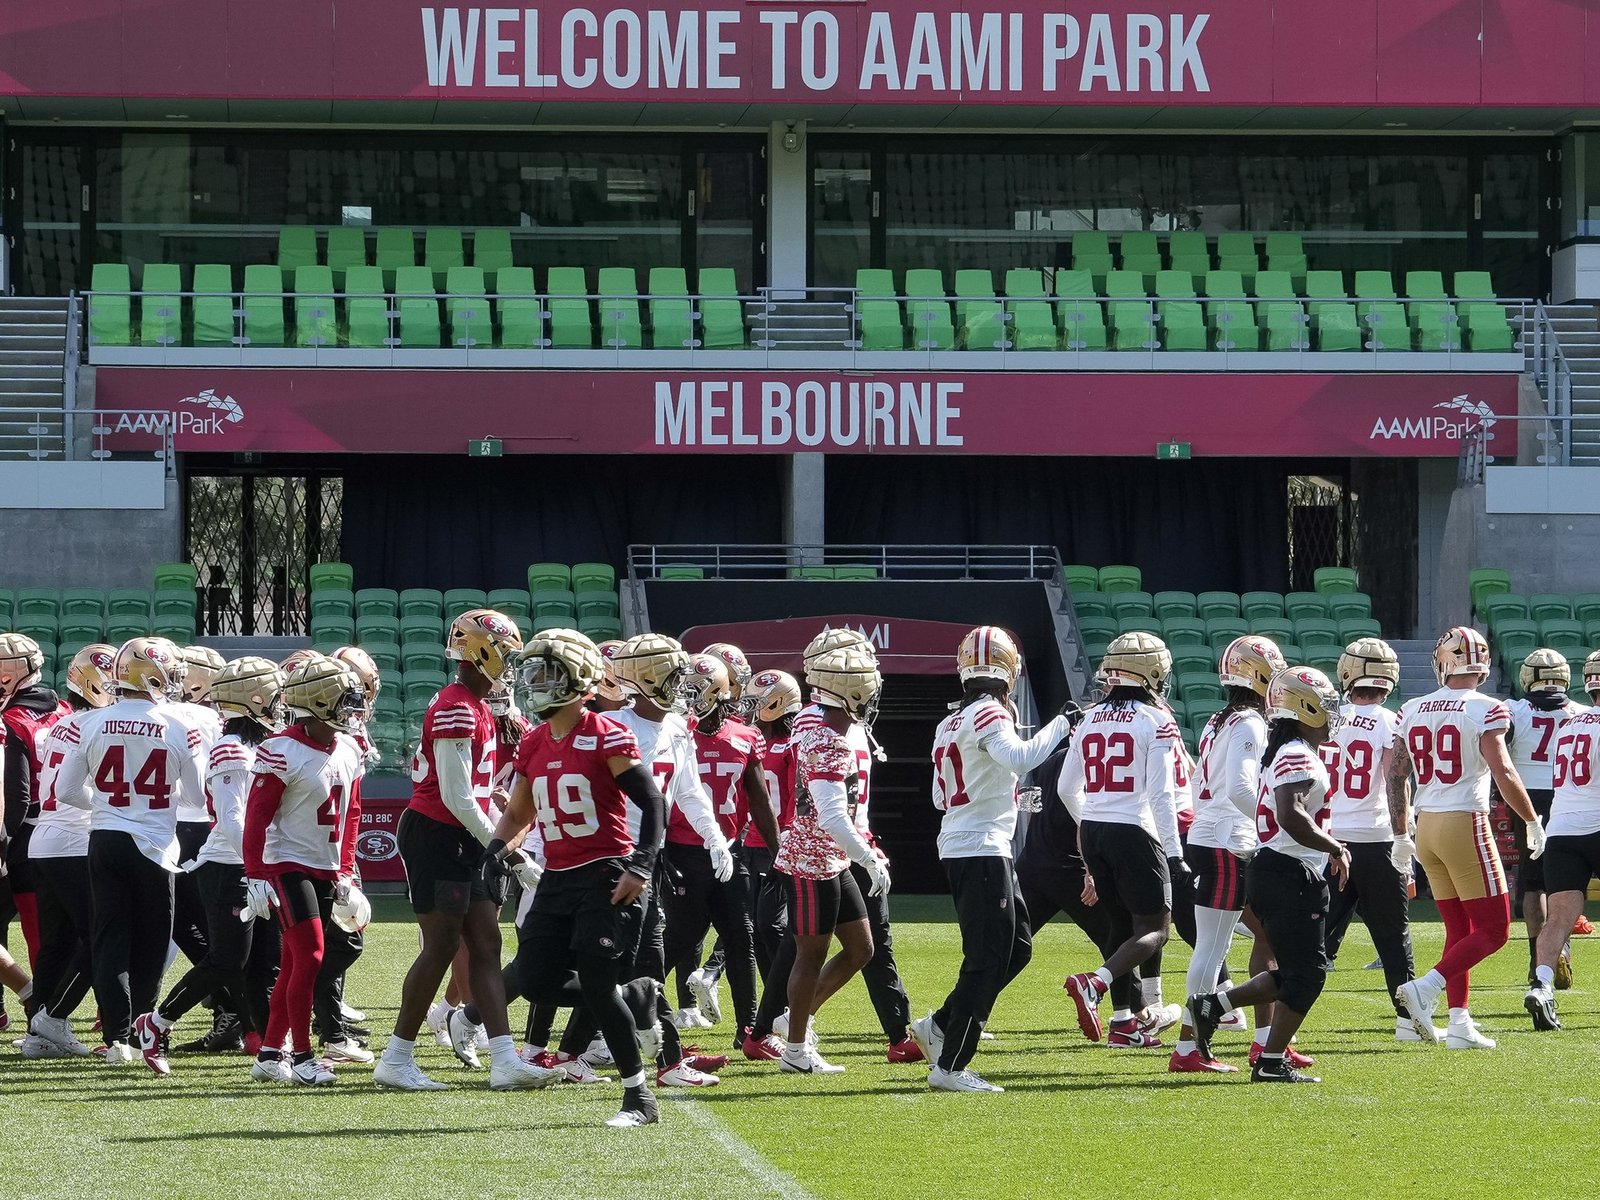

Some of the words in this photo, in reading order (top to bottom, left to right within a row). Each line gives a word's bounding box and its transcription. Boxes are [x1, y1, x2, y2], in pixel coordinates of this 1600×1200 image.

[421, 8, 740, 90] WELCOME
[760, 10, 840, 91] TO
[859, 12, 1023, 91] AAMI
[1043, 13, 1211, 92] PARK
[115, 413, 177, 434] AAMI
[180, 411, 224, 434] Park
[655, 380, 964, 446] MELBOURNE
[1370, 417, 1430, 439] AAMI
[1434, 417, 1478, 439] Park
[823, 623, 889, 648] MI
[102, 720, 166, 738] JUSZCZYK
[1092, 711, 1136, 723] DINKINS
[1418, 700, 1465, 714] FARRELL
[95, 745, 171, 810] 44
[1082, 732, 1134, 793] 82
[1319, 739, 1373, 799] 88
[1408, 725, 1462, 784] 89
[1553, 734, 1591, 787] 58
[375, 813, 393, 823] 28C
[532, 773, 600, 841] 49
